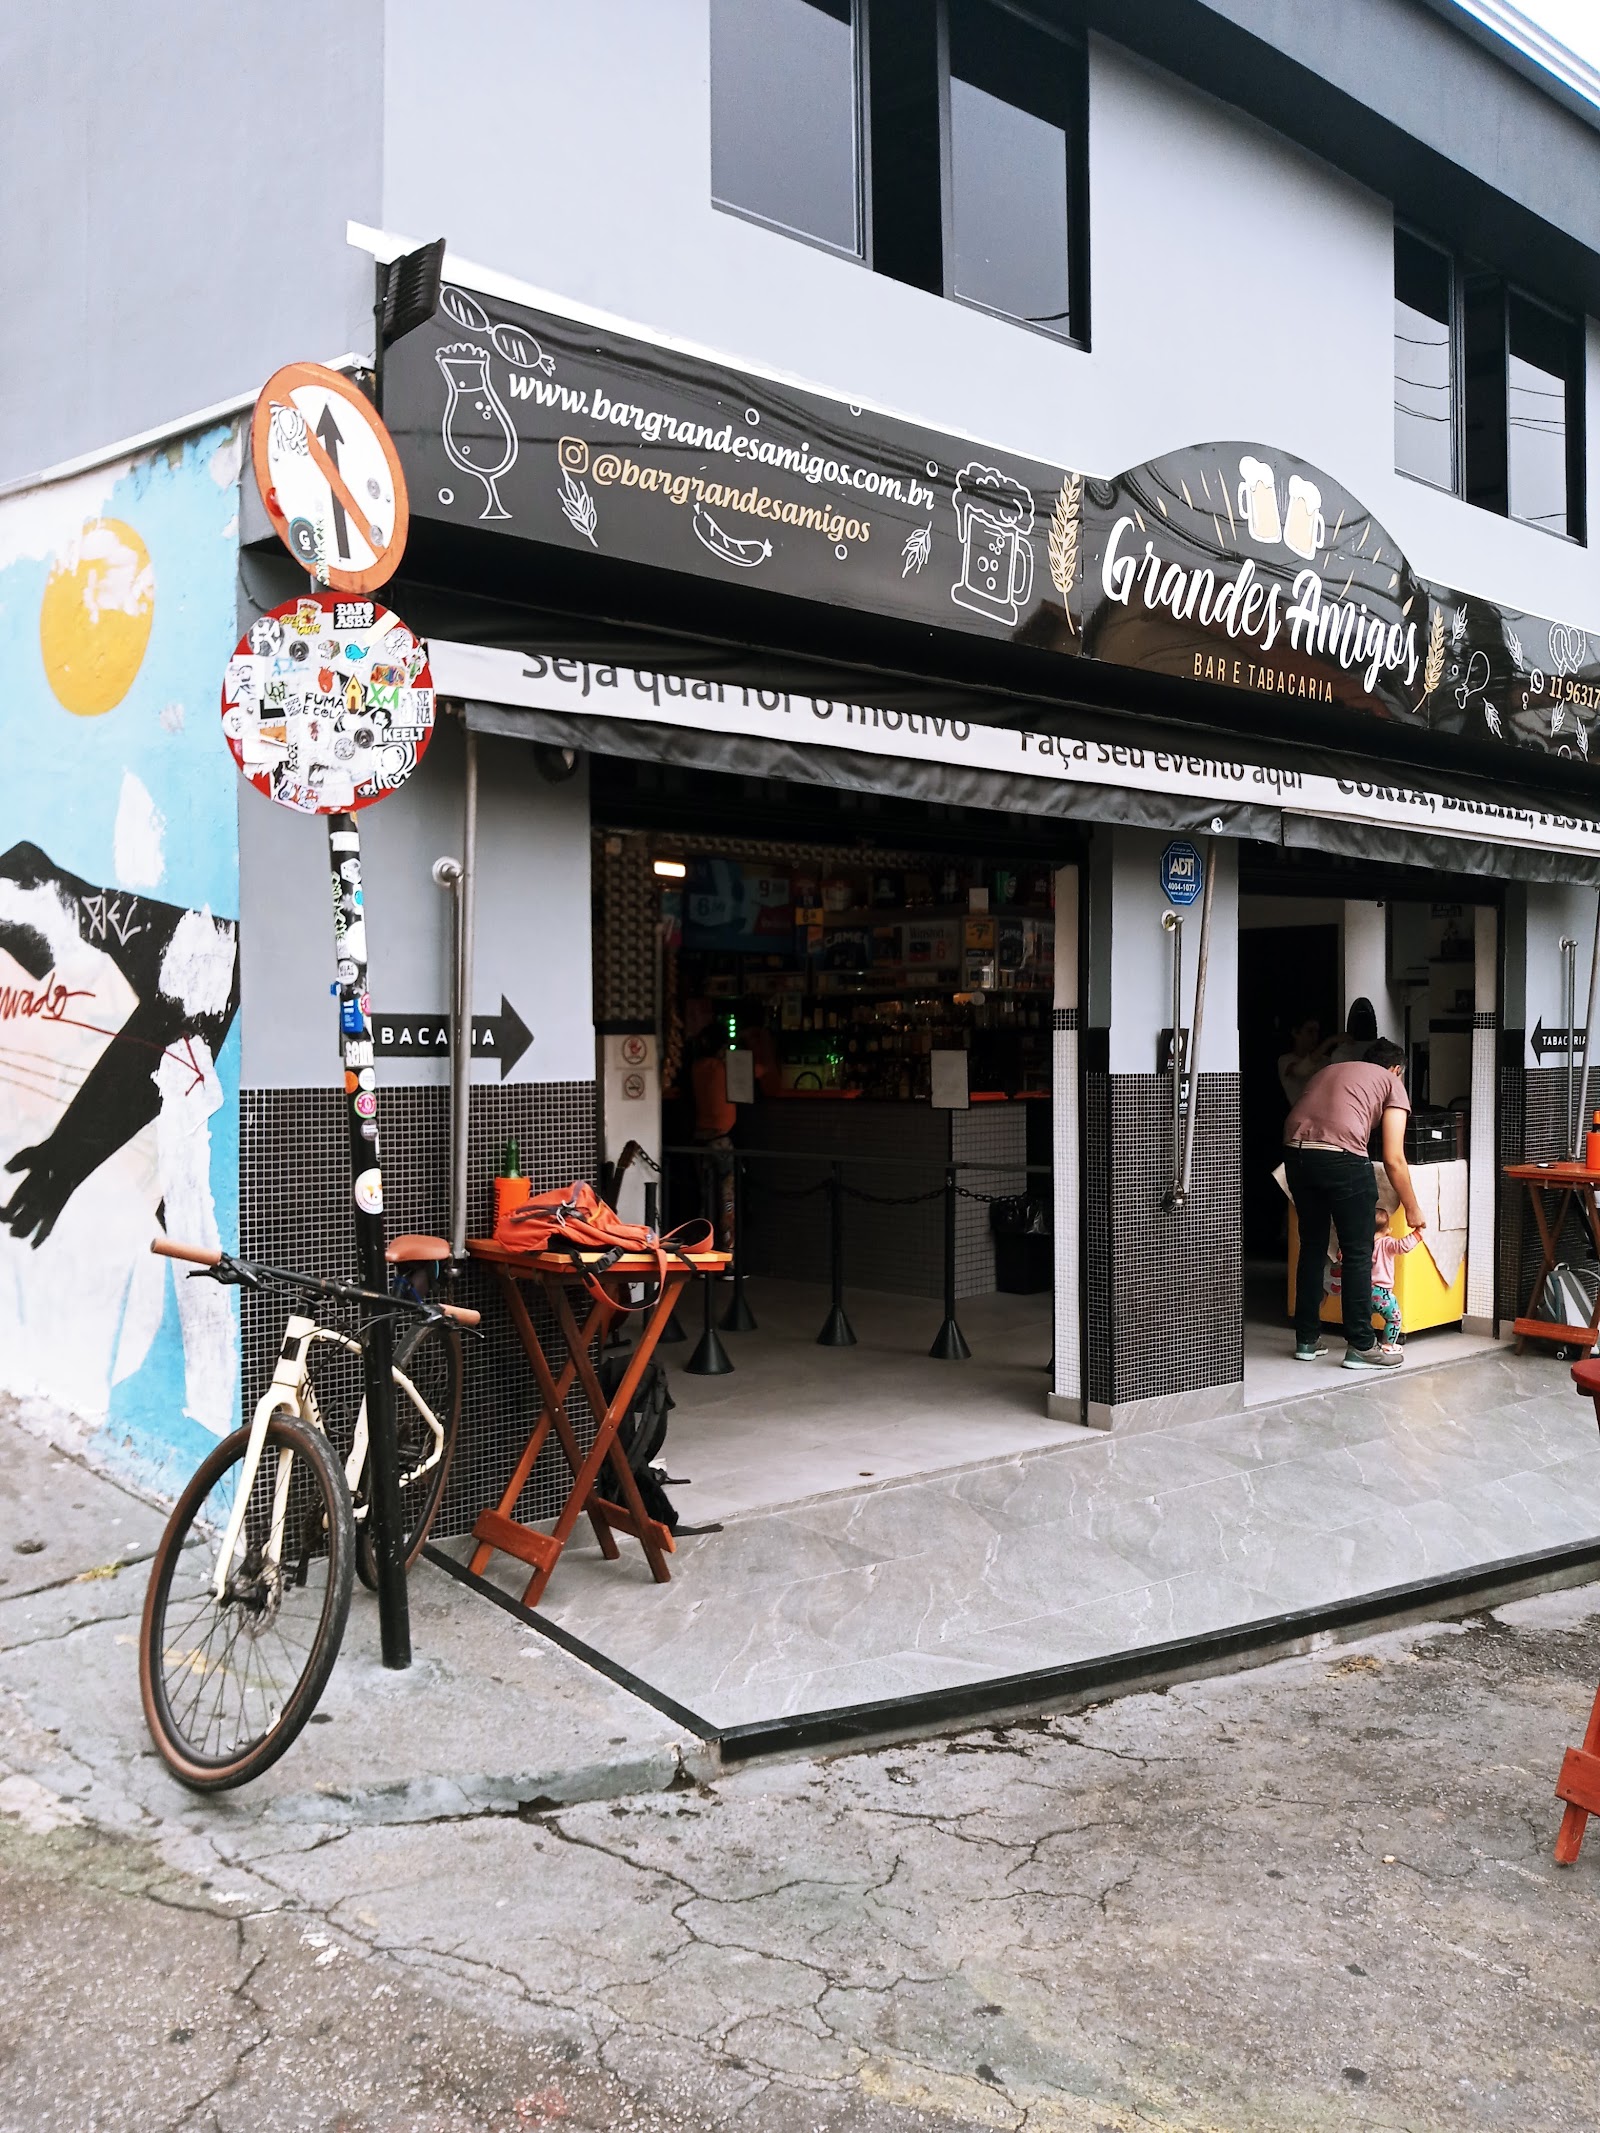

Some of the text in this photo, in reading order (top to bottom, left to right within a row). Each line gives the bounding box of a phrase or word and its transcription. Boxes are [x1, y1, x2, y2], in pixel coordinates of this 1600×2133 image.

[508, 372, 935, 510] www.bargrandesamigos.com.br
[592, 454, 870, 542] @bargrandesamigos
[1102, 516, 1419, 693] Grandes Amigos
[1194, 652, 1333, 704] BAR E TABACARIA
[1549, 676, 1563, 700] 11
[302, 705, 310, 715] E
[304, 692, 345, 710] FUMA
[382, 727, 425, 742] KEELT
[1096, 742, 1145, 769] seu
[1170, 857, 1194, 876] ADT
[1542, 1035, 1586, 1046] TABACRIA
